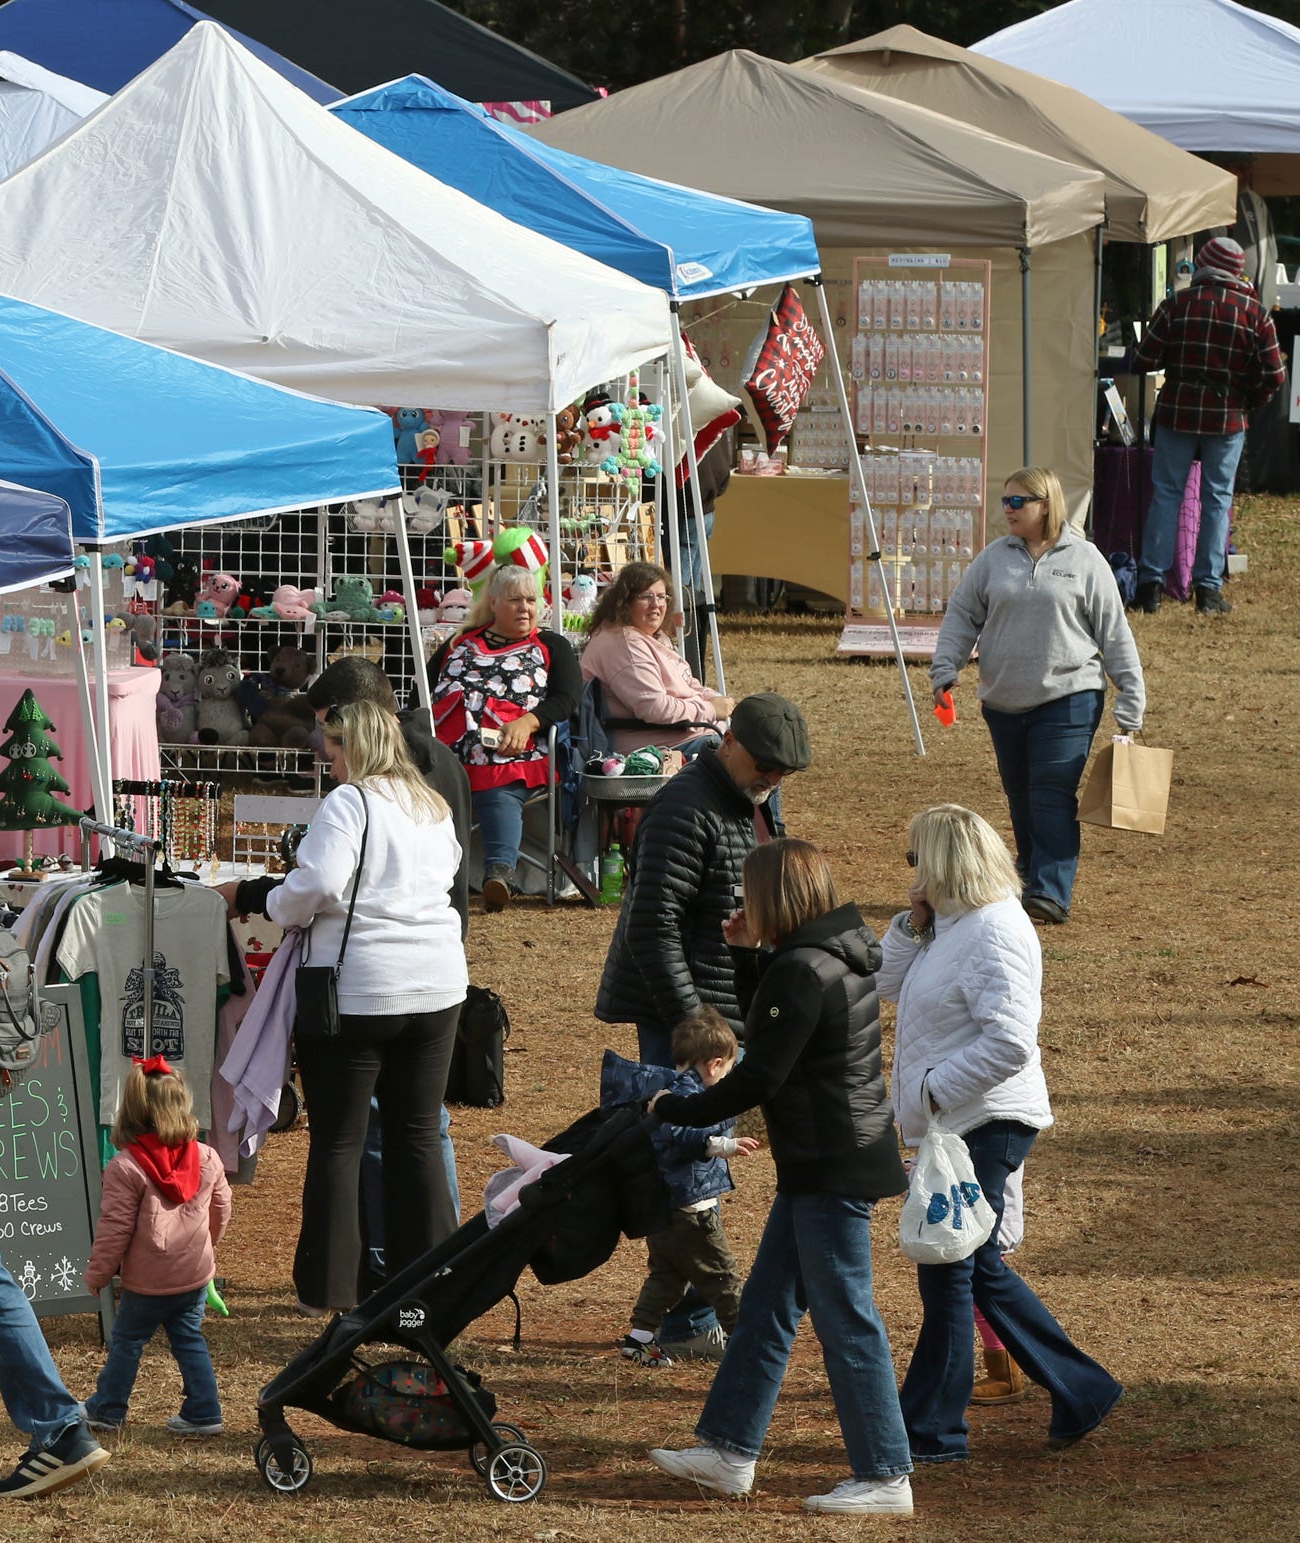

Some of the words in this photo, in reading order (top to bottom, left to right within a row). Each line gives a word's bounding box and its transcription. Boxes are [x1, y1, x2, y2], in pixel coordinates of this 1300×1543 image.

[128, 1003, 177, 1018] TEILA
[152, 1028, 168, 1036] ORTH
[399, 1309, 419, 1320] baby
[399, 1318, 424, 1328] jogger
